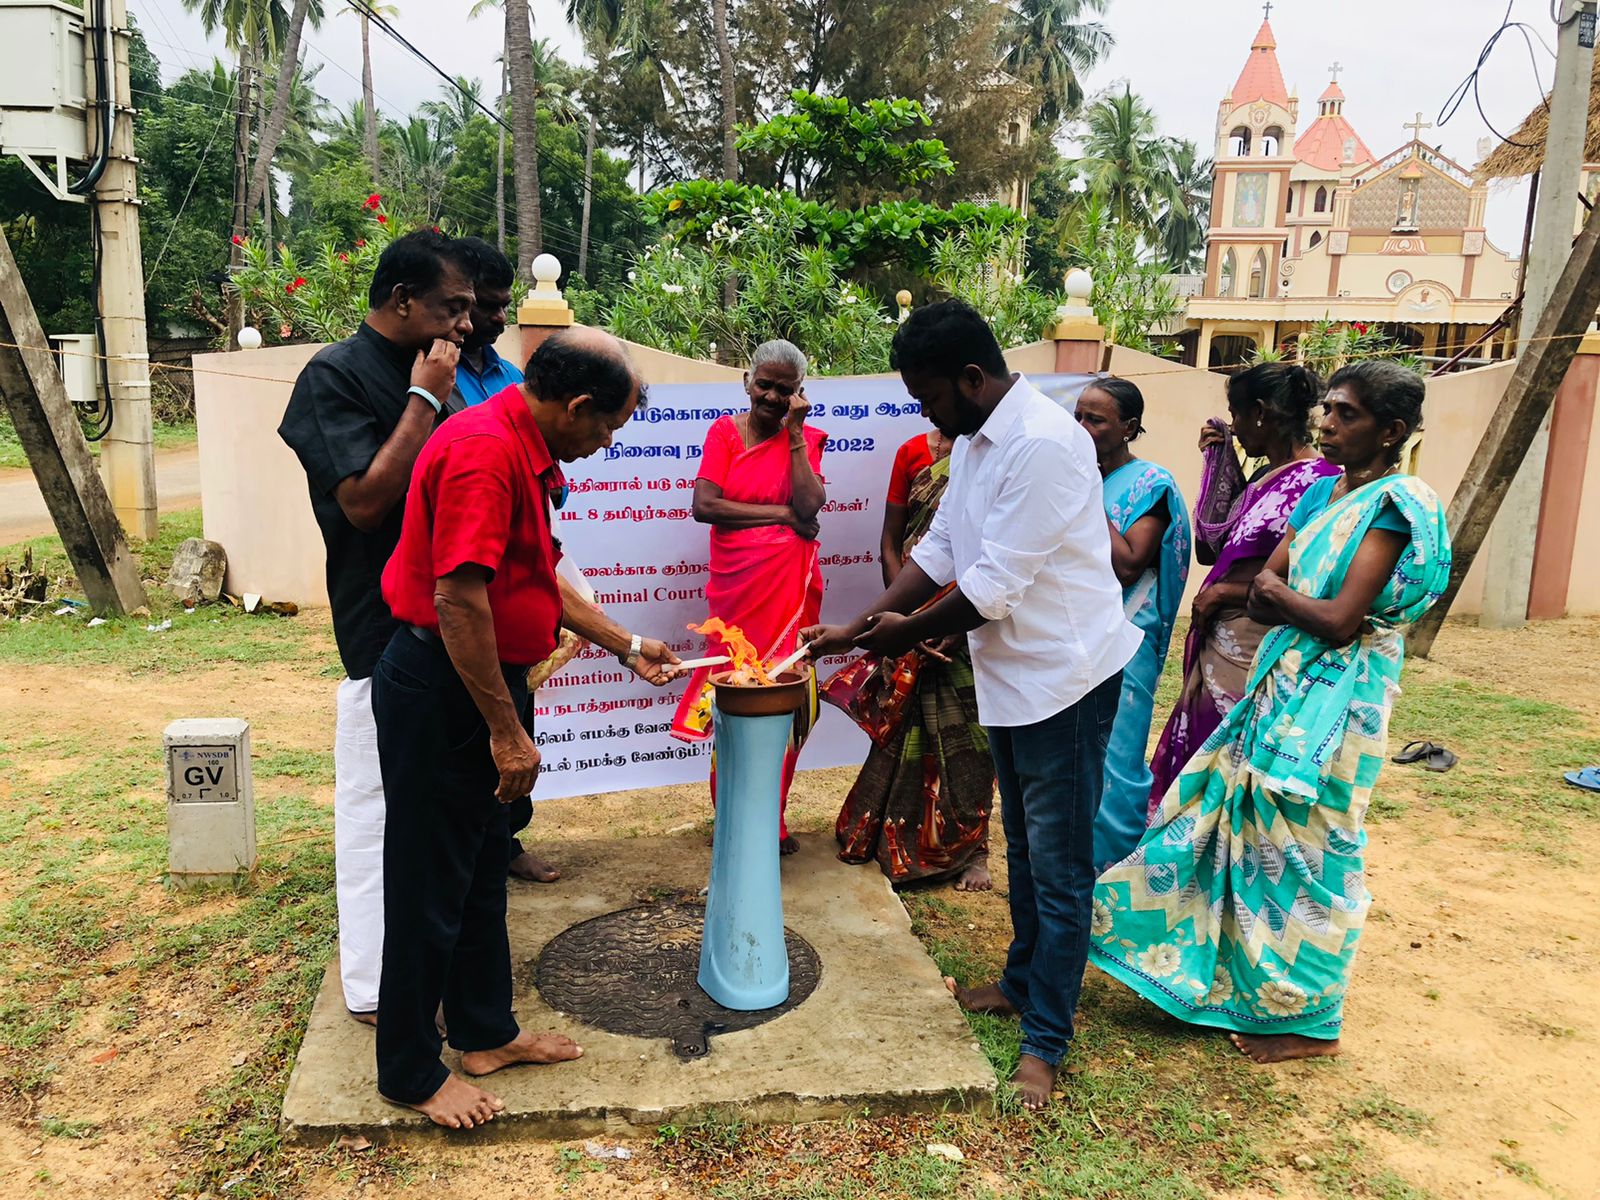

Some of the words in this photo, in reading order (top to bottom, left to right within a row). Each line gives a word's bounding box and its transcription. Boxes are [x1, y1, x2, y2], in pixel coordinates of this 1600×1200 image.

[832, 405, 869, 420] வது
[604, 442, 680, 461] நினைவு
[825, 438, 875, 452] 2022
[647, 478, 671, 491] படு
[559, 511, 583, 521] பட
[588, 508, 599, 520] 8
[821, 498, 869, 513] லிகள்!
[579, 563, 657, 577] லைக்காக
[818, 551, 874, 566] வதேசக்
[594, 588, 648, 604] iminal
[554, 698, 653, 717] நடாத்துமாறு
[580, 724, 630, 740] எமக்கு
[575, 753, 627, 772] நமக்கு
[184, 766, 224, 786] GV
